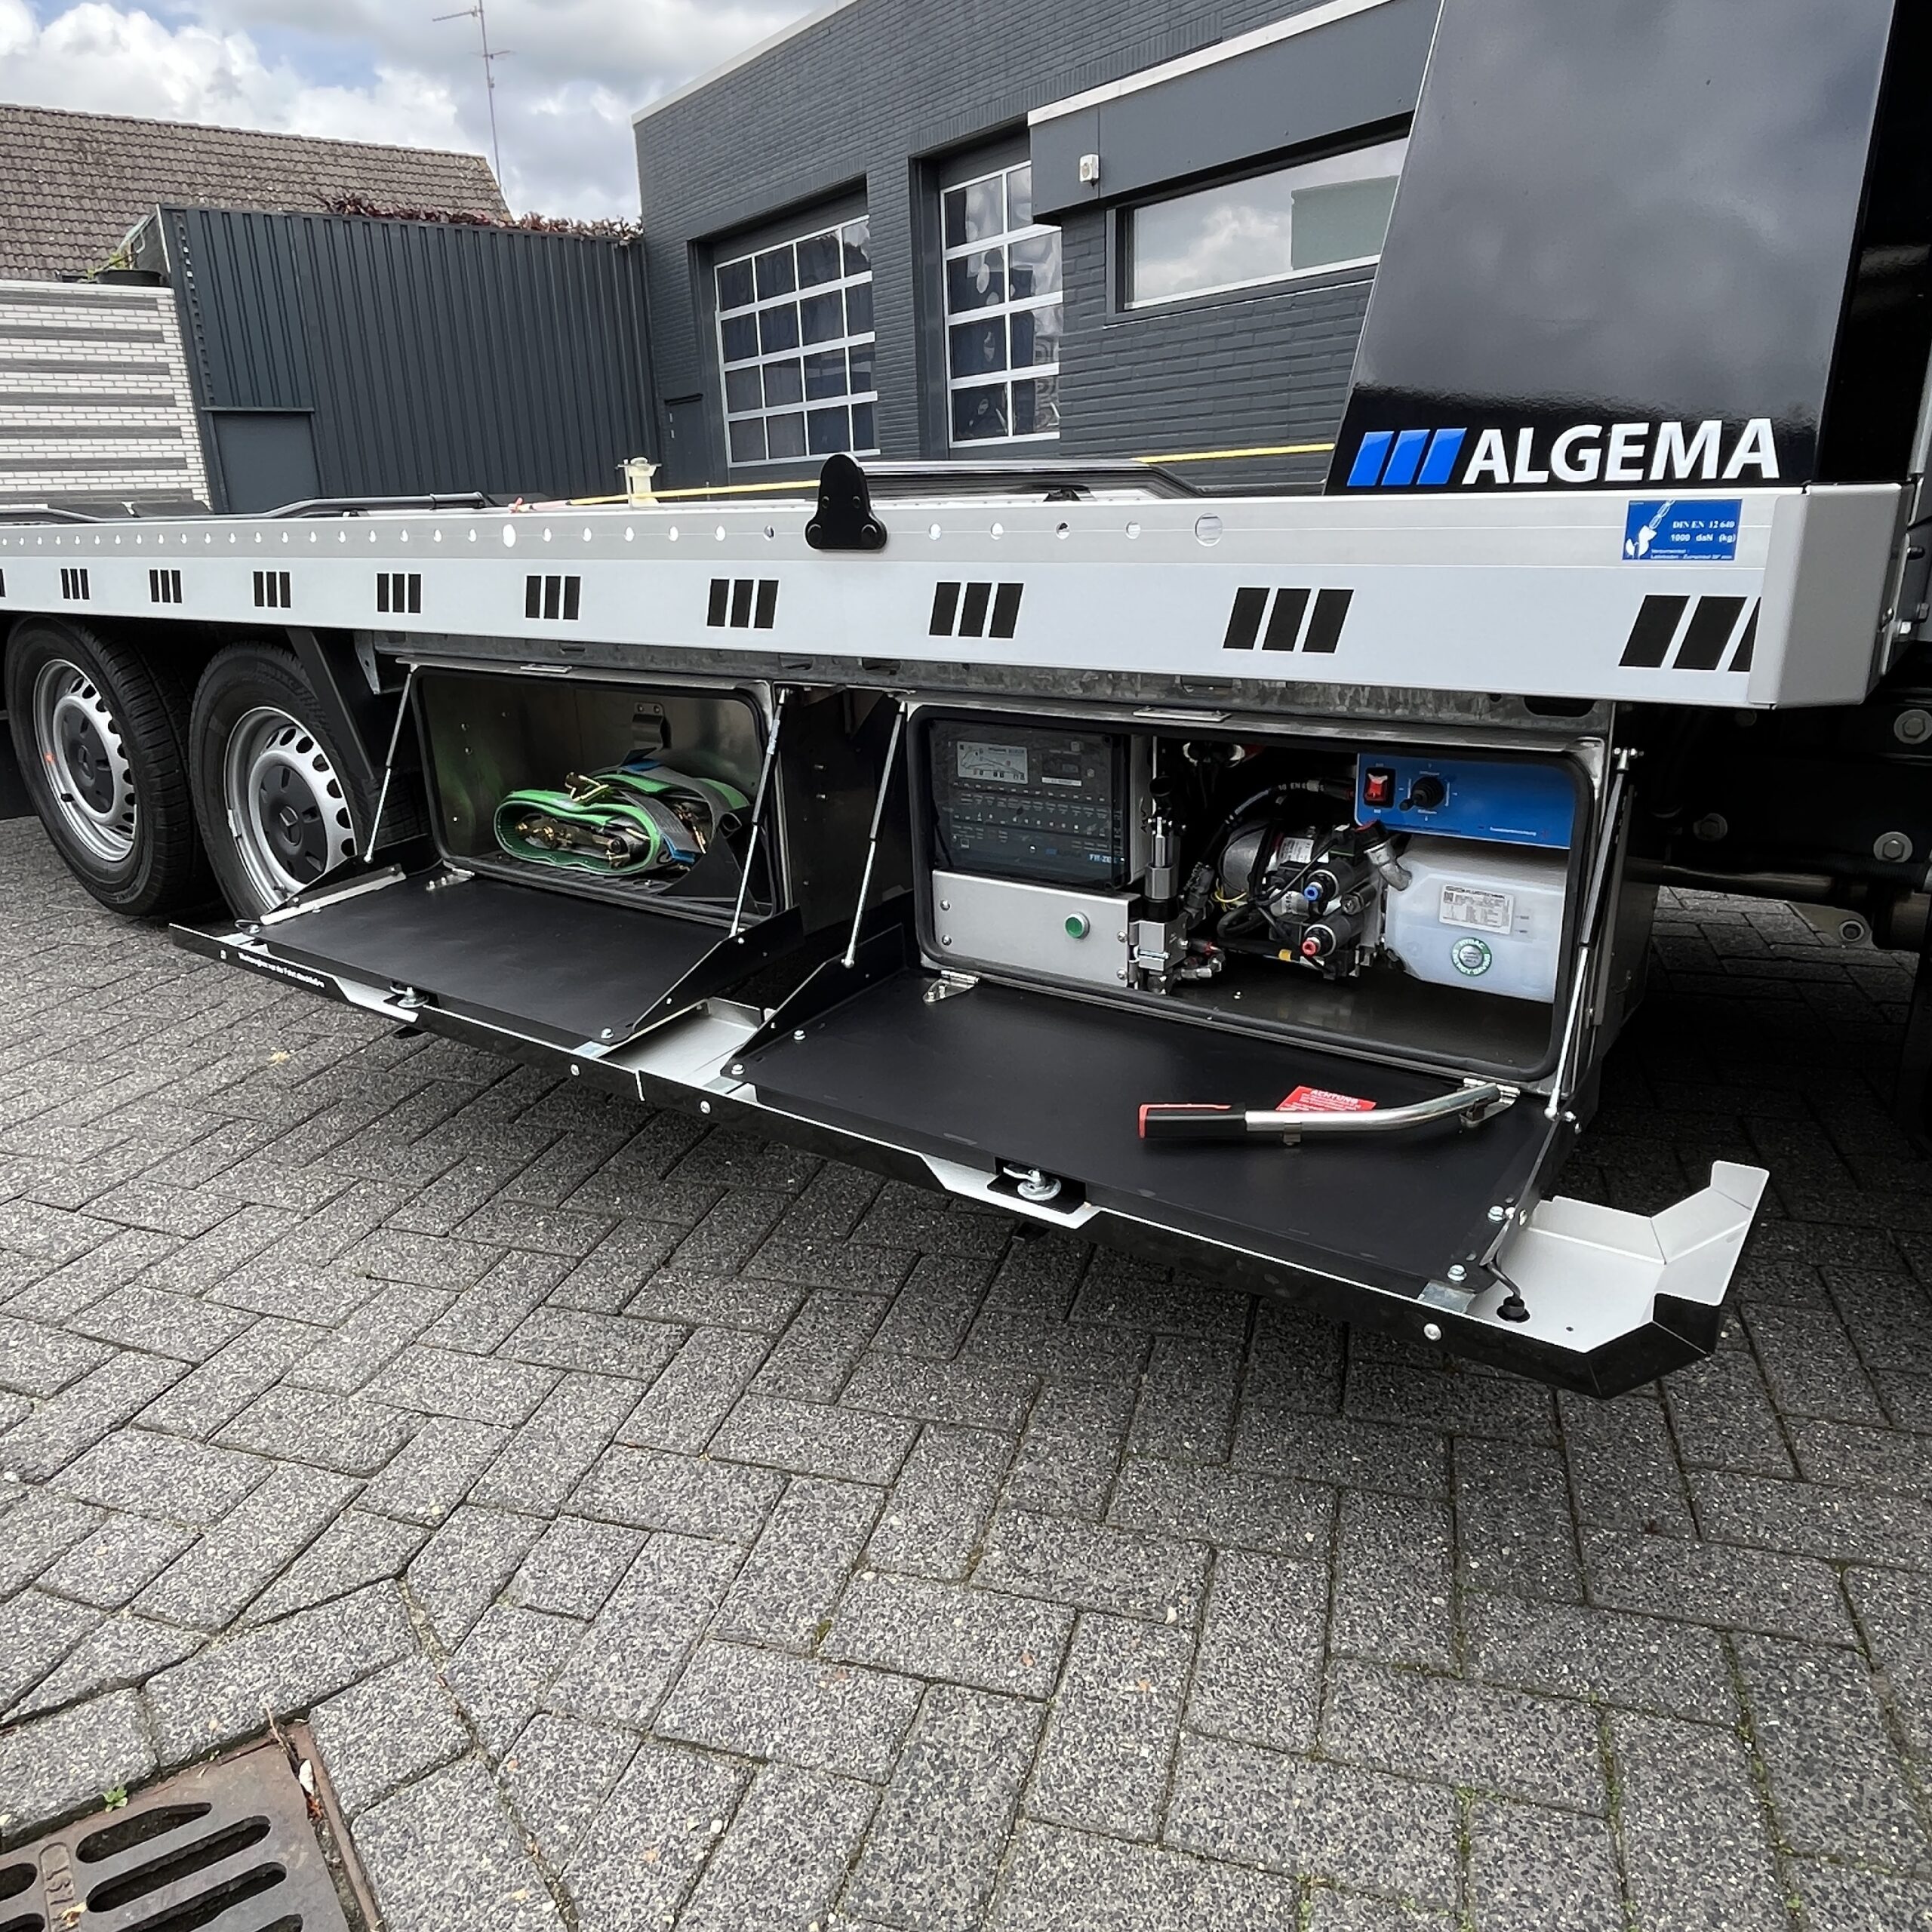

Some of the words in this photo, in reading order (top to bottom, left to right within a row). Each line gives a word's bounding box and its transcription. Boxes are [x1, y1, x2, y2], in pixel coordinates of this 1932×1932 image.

[1462, 417, 1780, 485] ALGEMA
[1672, 520, 1689, 528] DIN
[1690, 520, 1706, 528] EN
[1670, 533, 1690, 542] 1000
[1719, 533, 1736, 543] (kg)
[1310, 1089, 1359, 1104] ACHTUNG
